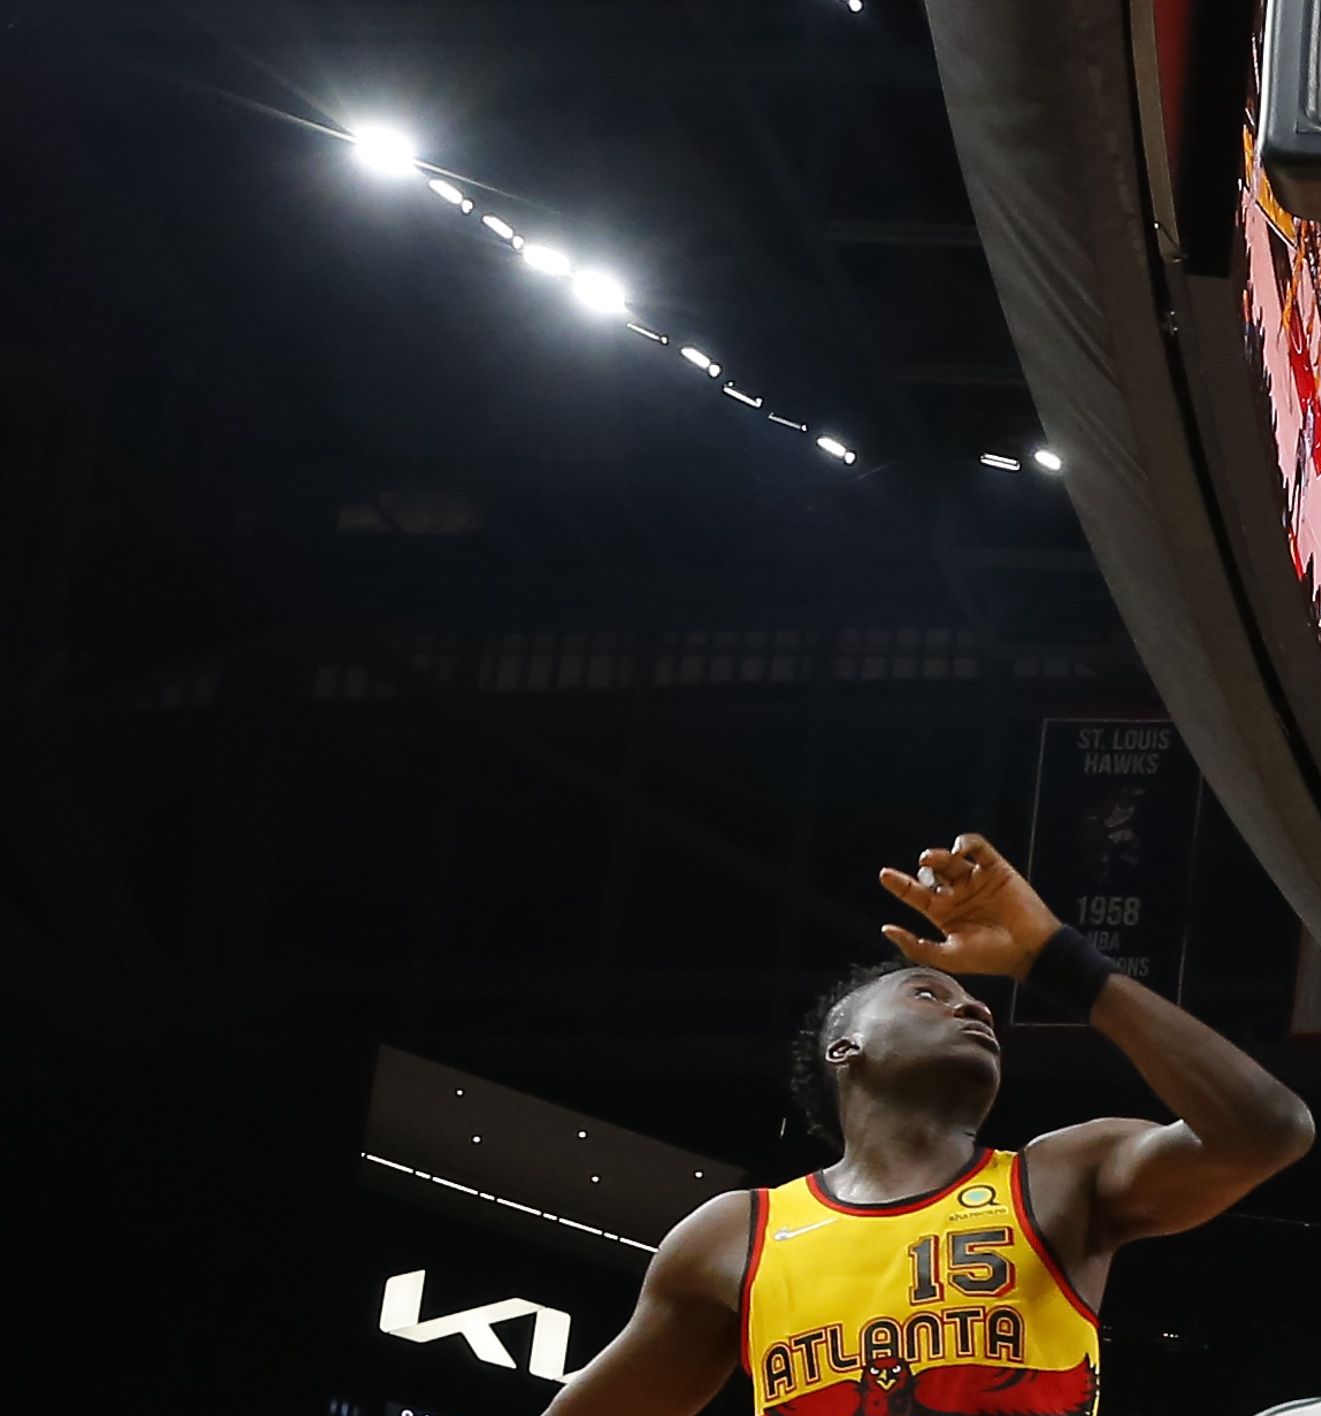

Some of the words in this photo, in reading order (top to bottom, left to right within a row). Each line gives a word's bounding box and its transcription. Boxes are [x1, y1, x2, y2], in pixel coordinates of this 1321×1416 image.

[1077, 729, 1106, 749] ST.
[1112, 729, 1171, 750] LOUIS
[1083, 753, 1159, 774] HAWKS
[1078, 896, 1140, 926] 1958
[908, 1226, 1017, 1305] 15
[763, 1306, 1025, 1402] ATLANTA
